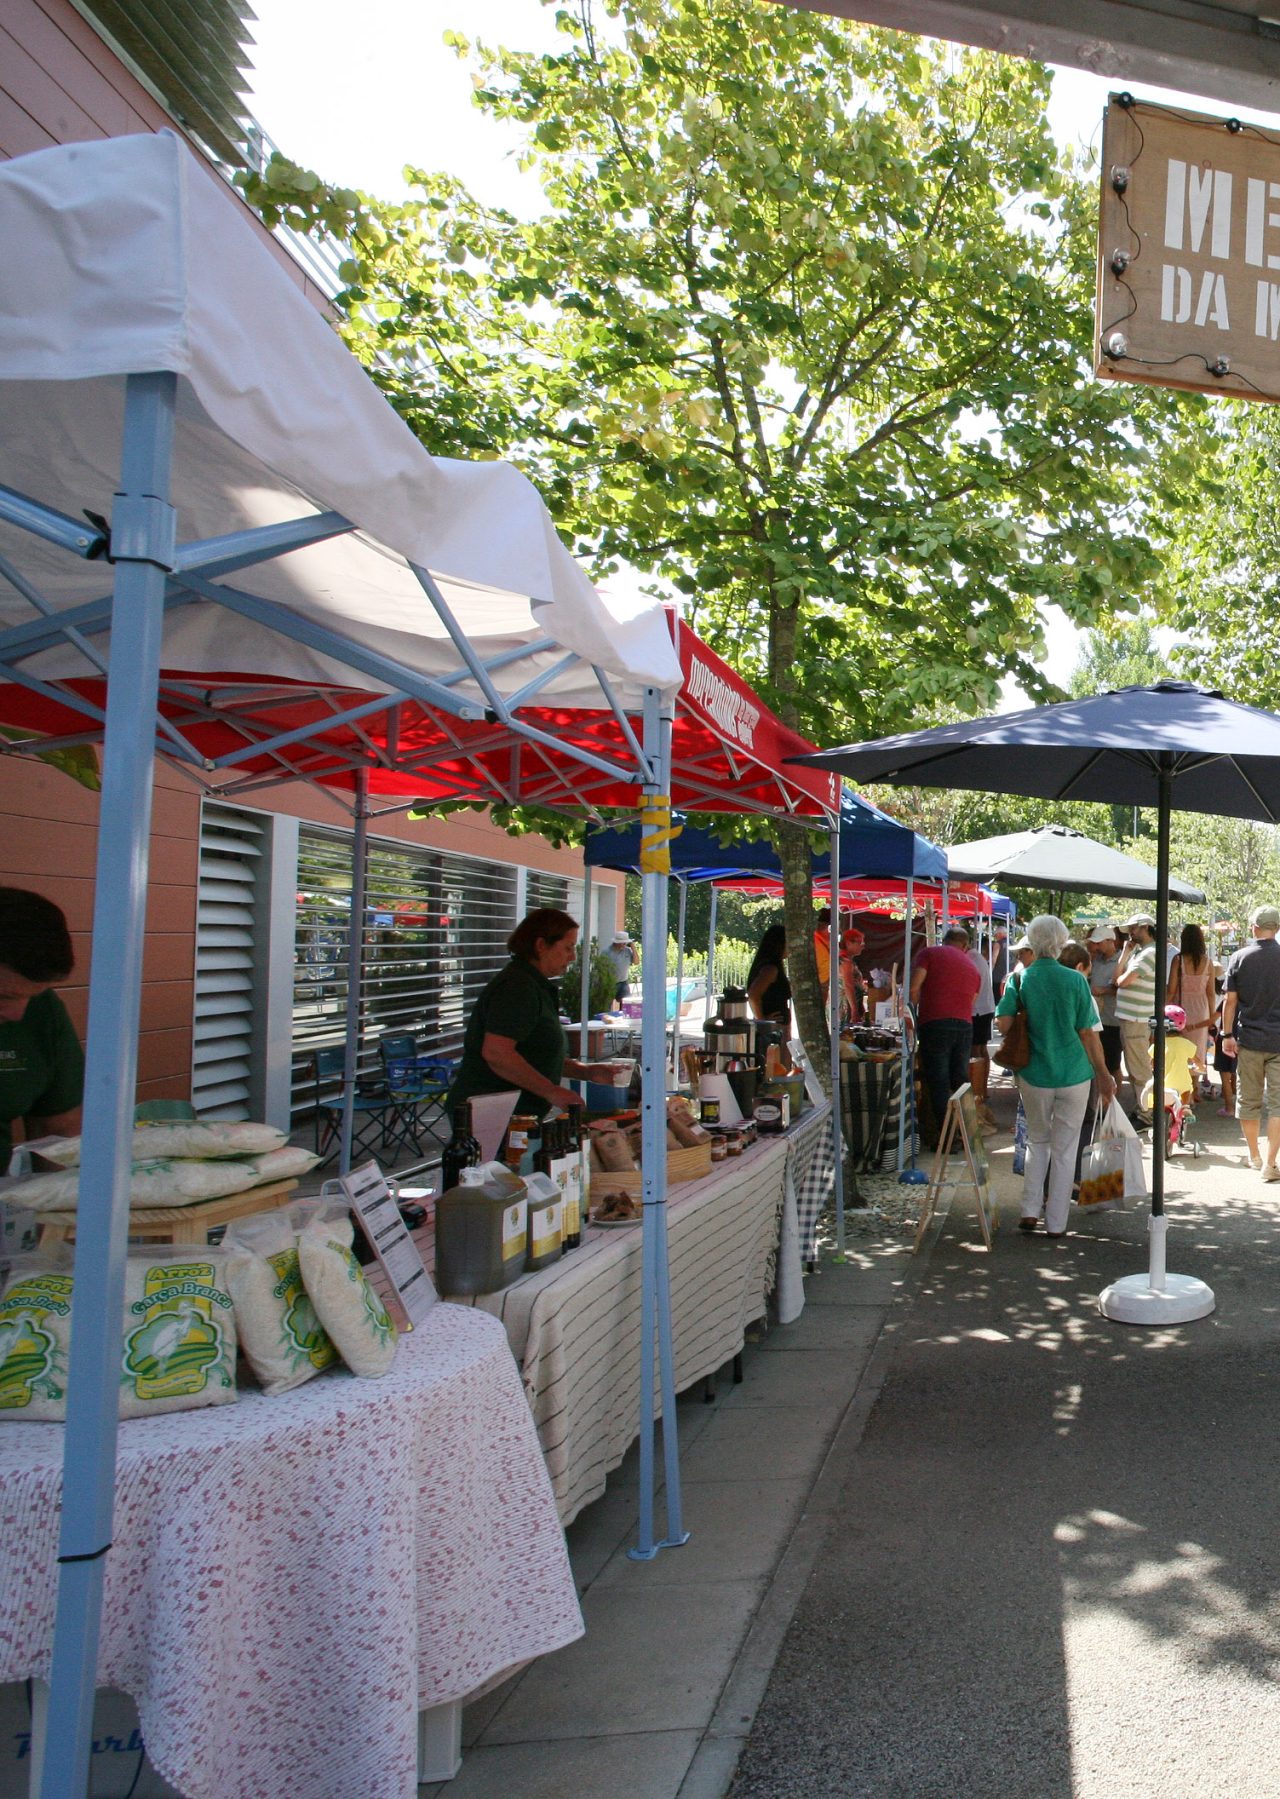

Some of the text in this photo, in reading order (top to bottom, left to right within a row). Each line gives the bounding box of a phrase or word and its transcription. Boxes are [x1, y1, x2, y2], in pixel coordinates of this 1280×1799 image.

[1160, 263, 1231, 331] DA
[148, 1267, 213, 1281] Arroz
[132, 1281, 233, 1315] Garça Branca
